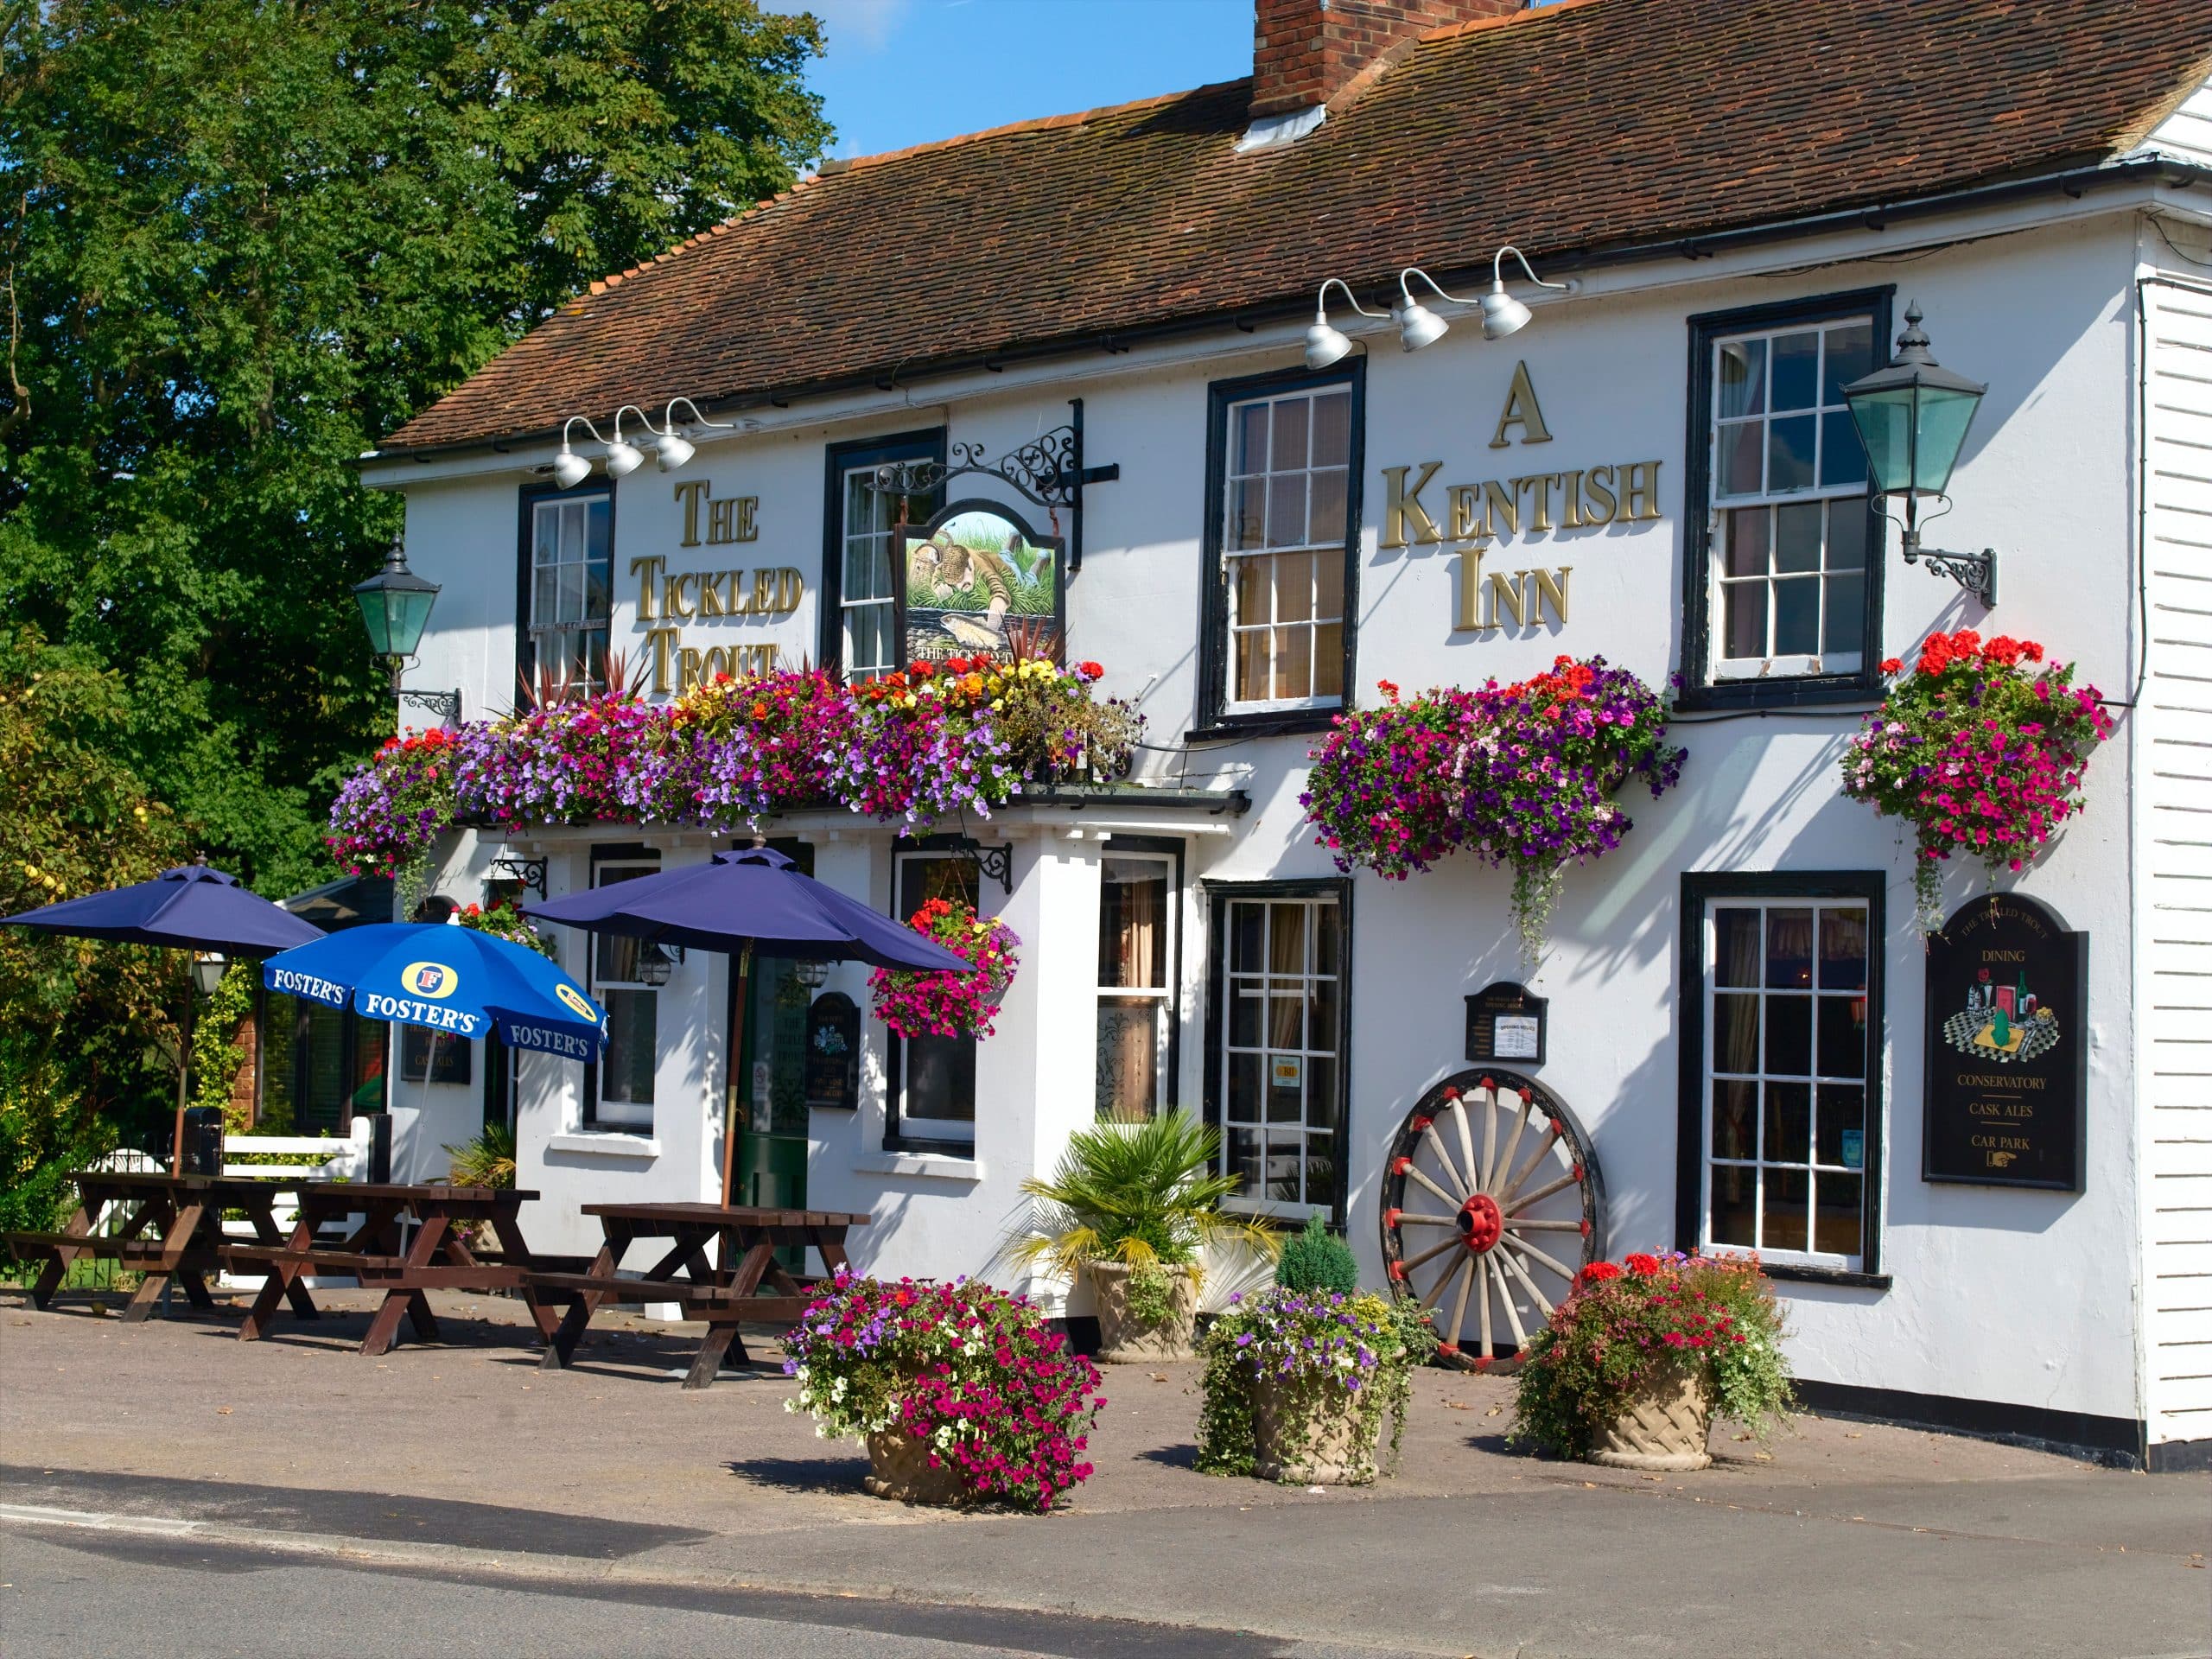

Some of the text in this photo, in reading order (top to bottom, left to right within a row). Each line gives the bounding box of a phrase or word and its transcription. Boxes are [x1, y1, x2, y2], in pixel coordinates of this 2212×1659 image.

[1488, 360, 1553, 448] A
[674, 479, 760, 547] THE
[1380, 460, 1663, 549] KENTISH
[630, 555, 804, 620] TICKLED
[1454, 547, 1573, 632] INN
[646, 626, 779, 692] TROUT
[1982, 950, 2025, 962] DINING
[274, 969, 345, 1005] FOSTER'S
[417, 969, 442, 988] F
[365, 994, 476, 1033] FOSTER'S
[510, 1024, 588, 1057] FOSTER'S
[1957, 1074, 2047, 1090] CONSERVATORY
[1969, 1103, 2033, 1117] CASK ALES
[1971, 1135, 2030, 1150] CAR PARK
